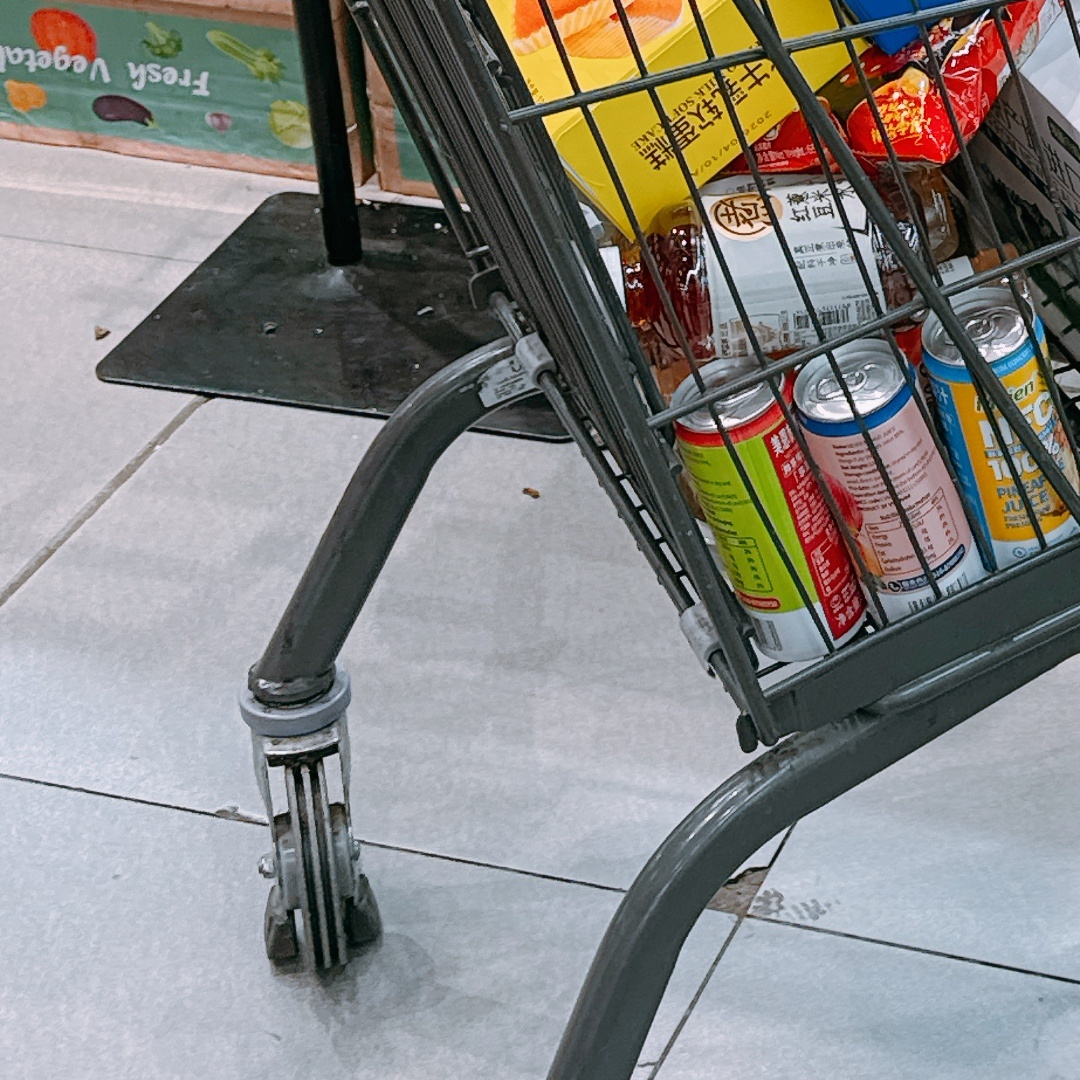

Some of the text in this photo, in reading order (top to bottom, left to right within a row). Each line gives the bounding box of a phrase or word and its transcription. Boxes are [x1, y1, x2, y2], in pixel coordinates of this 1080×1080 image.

[128, 61, 211, 97] Fresh
[638, 61, 777, 171] 牛乳软蛋糕
[1002, 489, 1050, 513] JUCE
